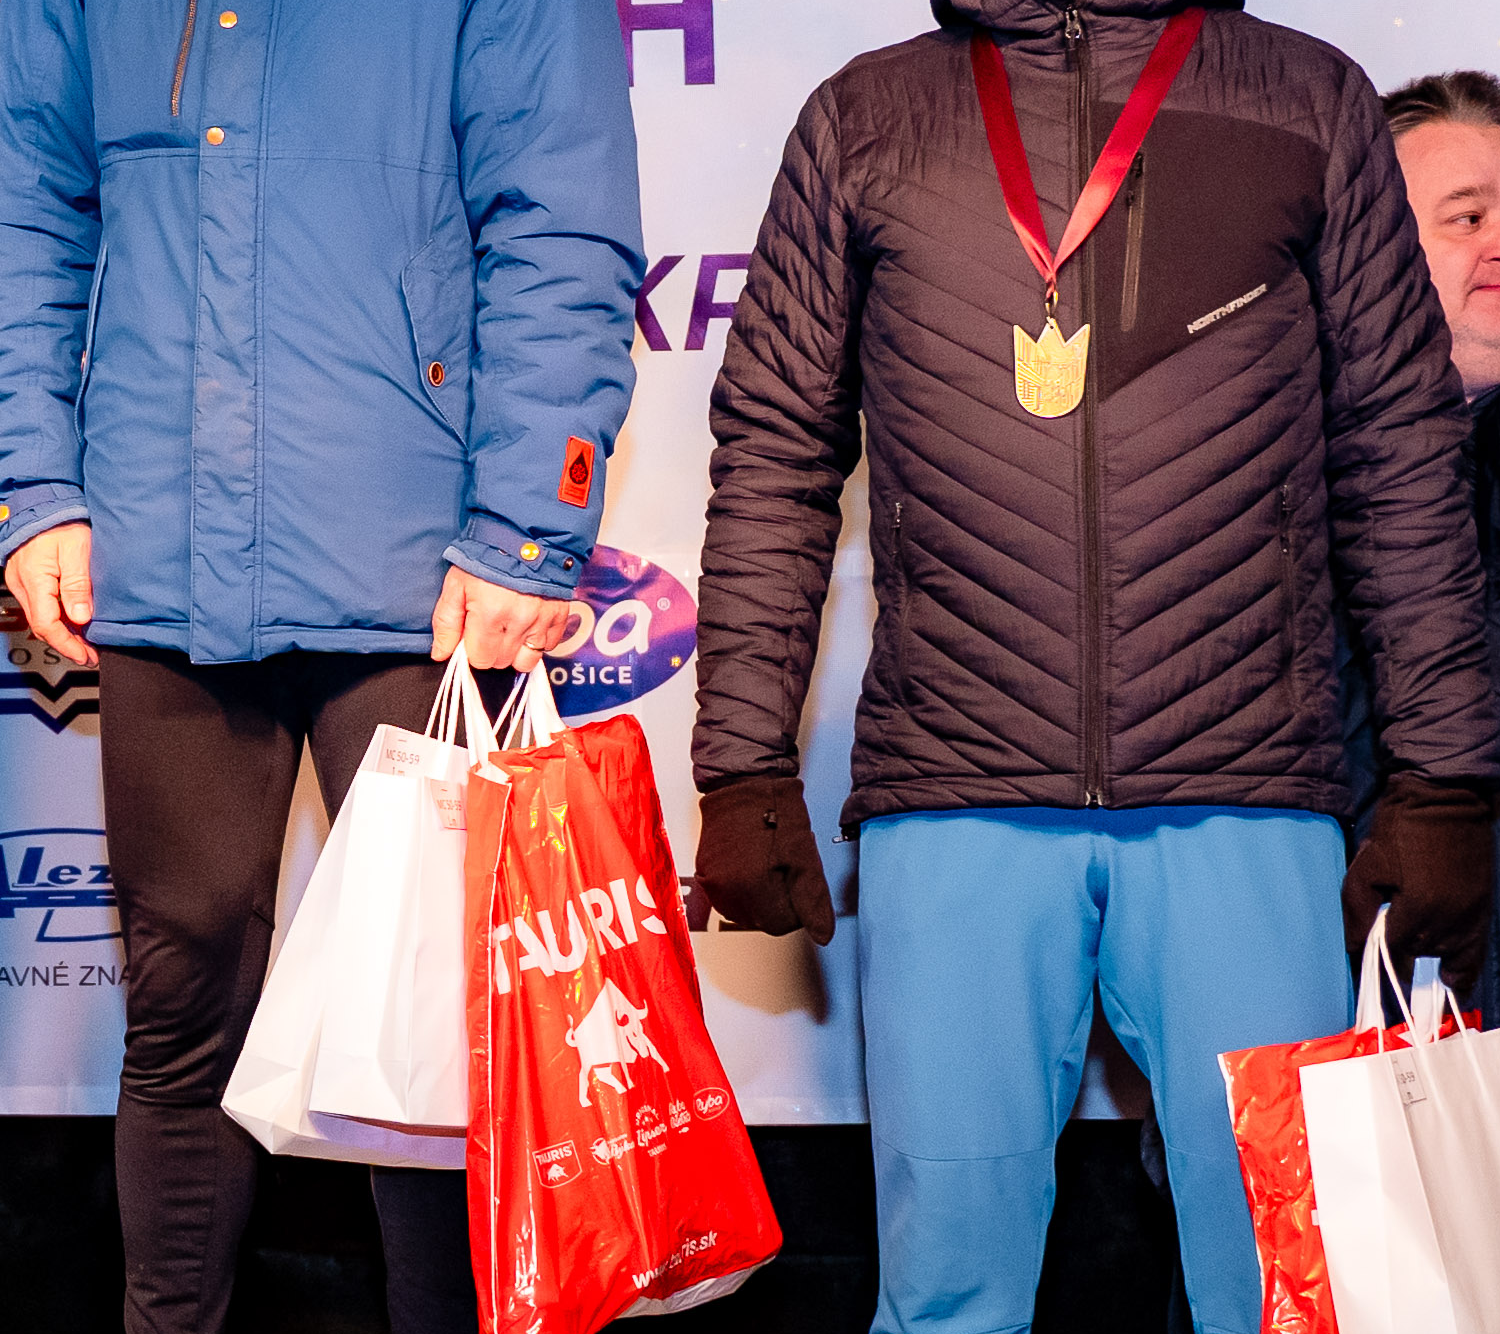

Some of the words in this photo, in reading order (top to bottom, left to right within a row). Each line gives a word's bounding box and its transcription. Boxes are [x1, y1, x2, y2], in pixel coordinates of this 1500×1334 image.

[550, 662, 633, 686] OŠICE
[492, 874, 668, 995] TAURIS
[535, 1145, 573, 1166] TAURIS
